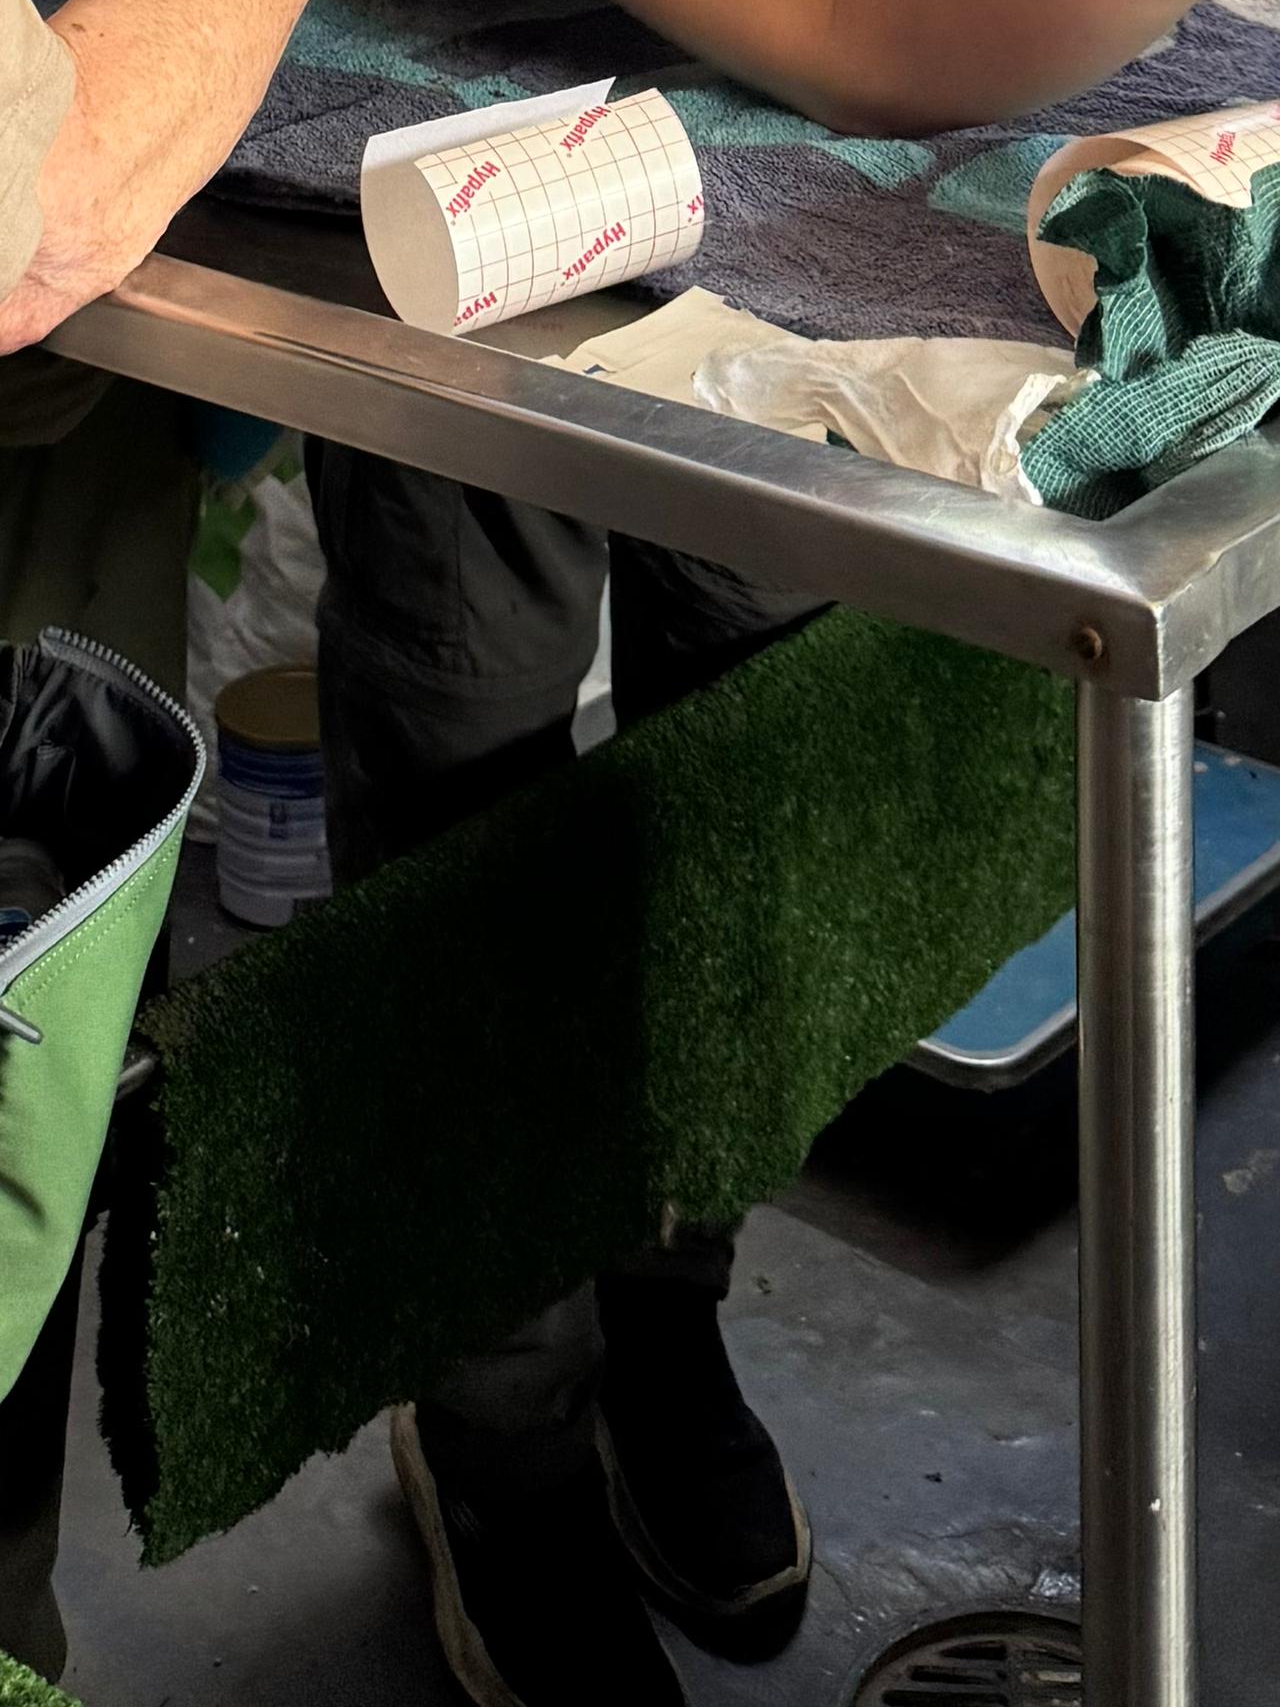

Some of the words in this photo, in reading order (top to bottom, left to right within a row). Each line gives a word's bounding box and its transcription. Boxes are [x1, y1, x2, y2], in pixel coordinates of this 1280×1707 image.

[559, 105, 611, 151] Hypafix
[445, 160, 501, 216] Hypafix
[562, 221, 627, 282] Hypafix
